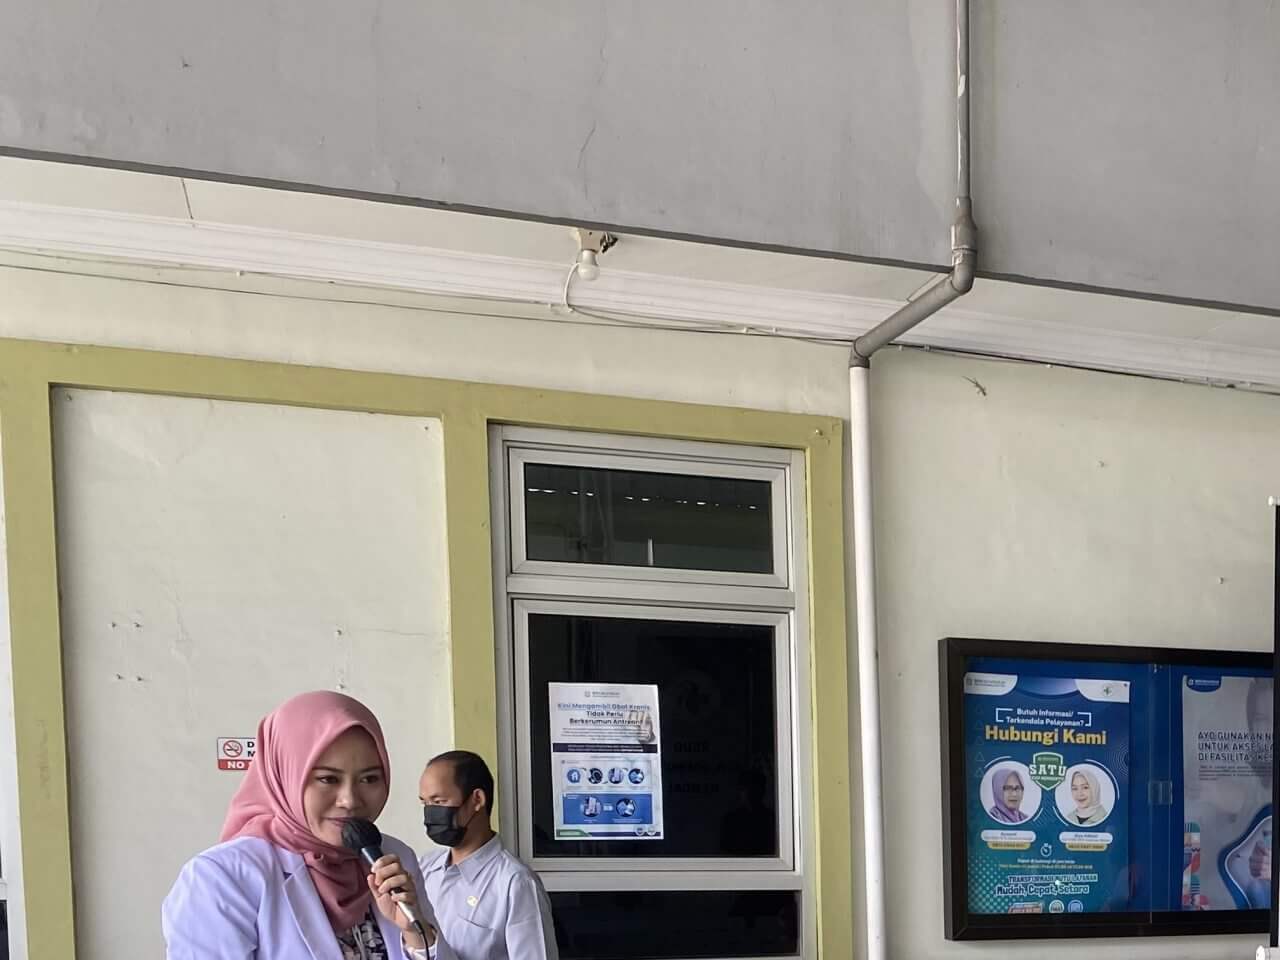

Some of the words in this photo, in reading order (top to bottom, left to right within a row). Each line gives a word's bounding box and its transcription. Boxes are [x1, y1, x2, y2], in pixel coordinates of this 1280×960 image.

[985, 725, 1059, 746] Hubungi
[1063, 729, 1107, 745] Kami
[1198, 731, 1217, 739] AYO
[1217, 731, 1262, 740] GUNAKAN
[1198, 742, 1229, 751] UNTUK
[1198, 753, 1208, 761] DI
[227, 761, 245, 769] NO
[1029, 764, 1067, 777] SATU
